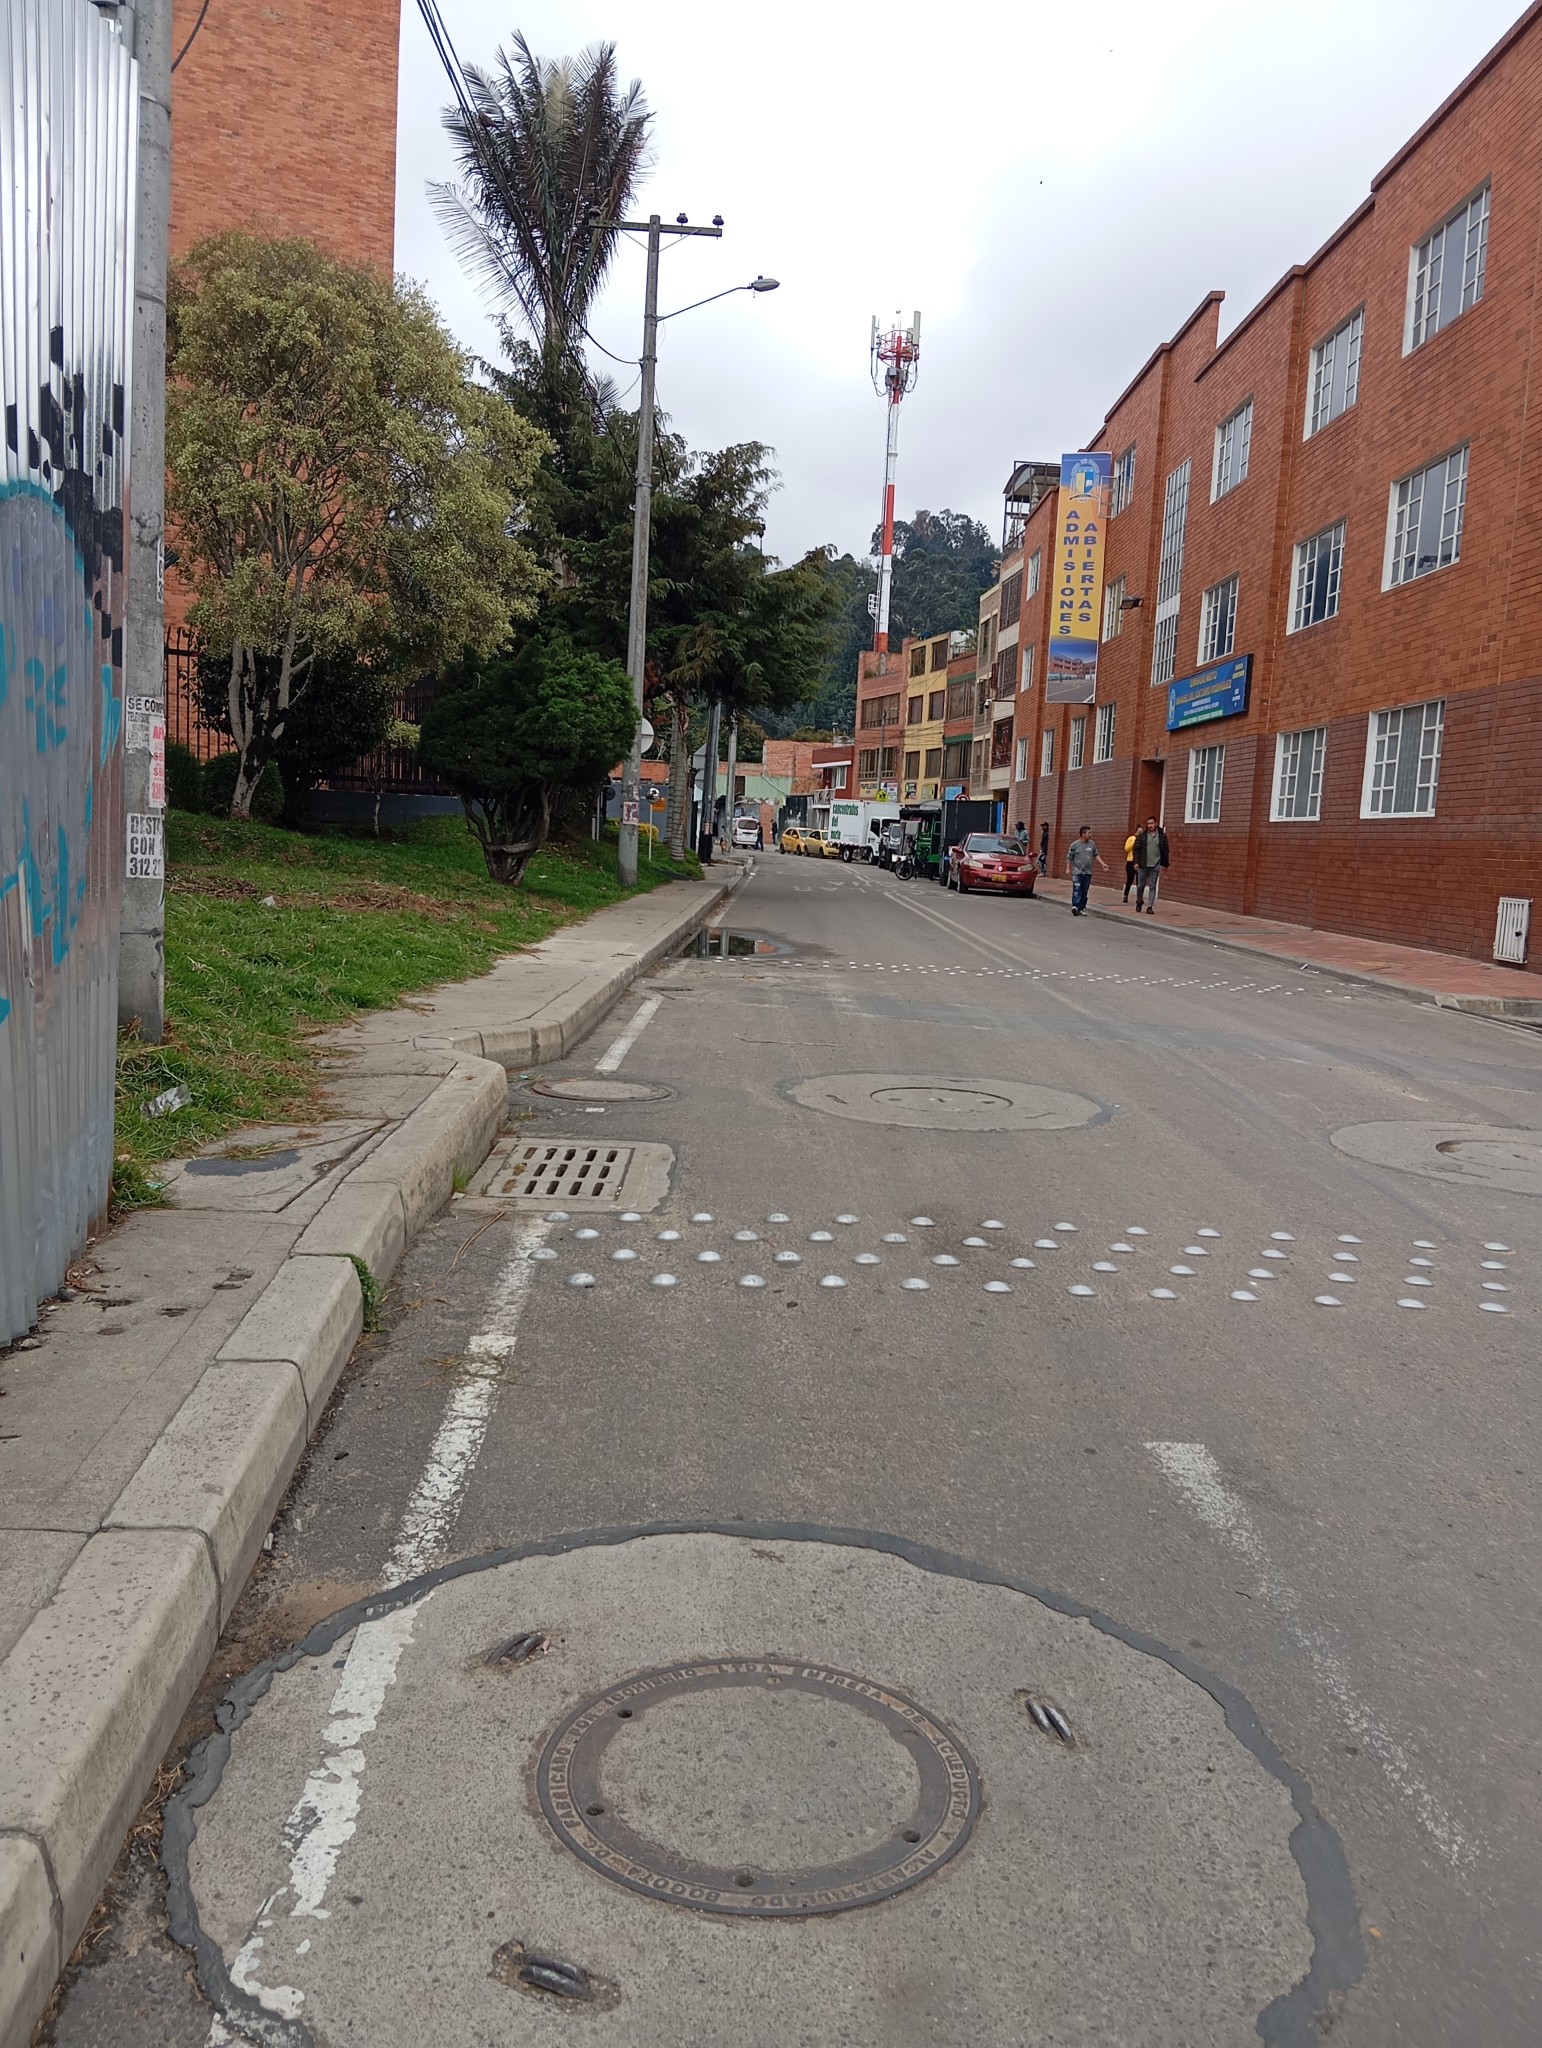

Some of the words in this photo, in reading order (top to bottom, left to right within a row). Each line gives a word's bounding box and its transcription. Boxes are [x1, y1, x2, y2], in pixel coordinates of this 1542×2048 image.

[1059, 510, 1080, 634] ADMISIONES
[1079, 523, 1098, 622] ABIERTAS
[128, 698, 142, 710] SE
[144, 699, 164, 713] COMP
[130, 837, 155, 855] CON
[130, 857, 150, 876] 312
[792, 1666, 882, 1700] EMPRESA
[901, 1708, 928, 1724] DE
[550, 1747, 582, 1829] FABRICADO
[568, 1713, 600, 1738] POR
[932, 1736, 969, 1819] ACUEDUCTO
[939, 1830, 952, 1841] Y
